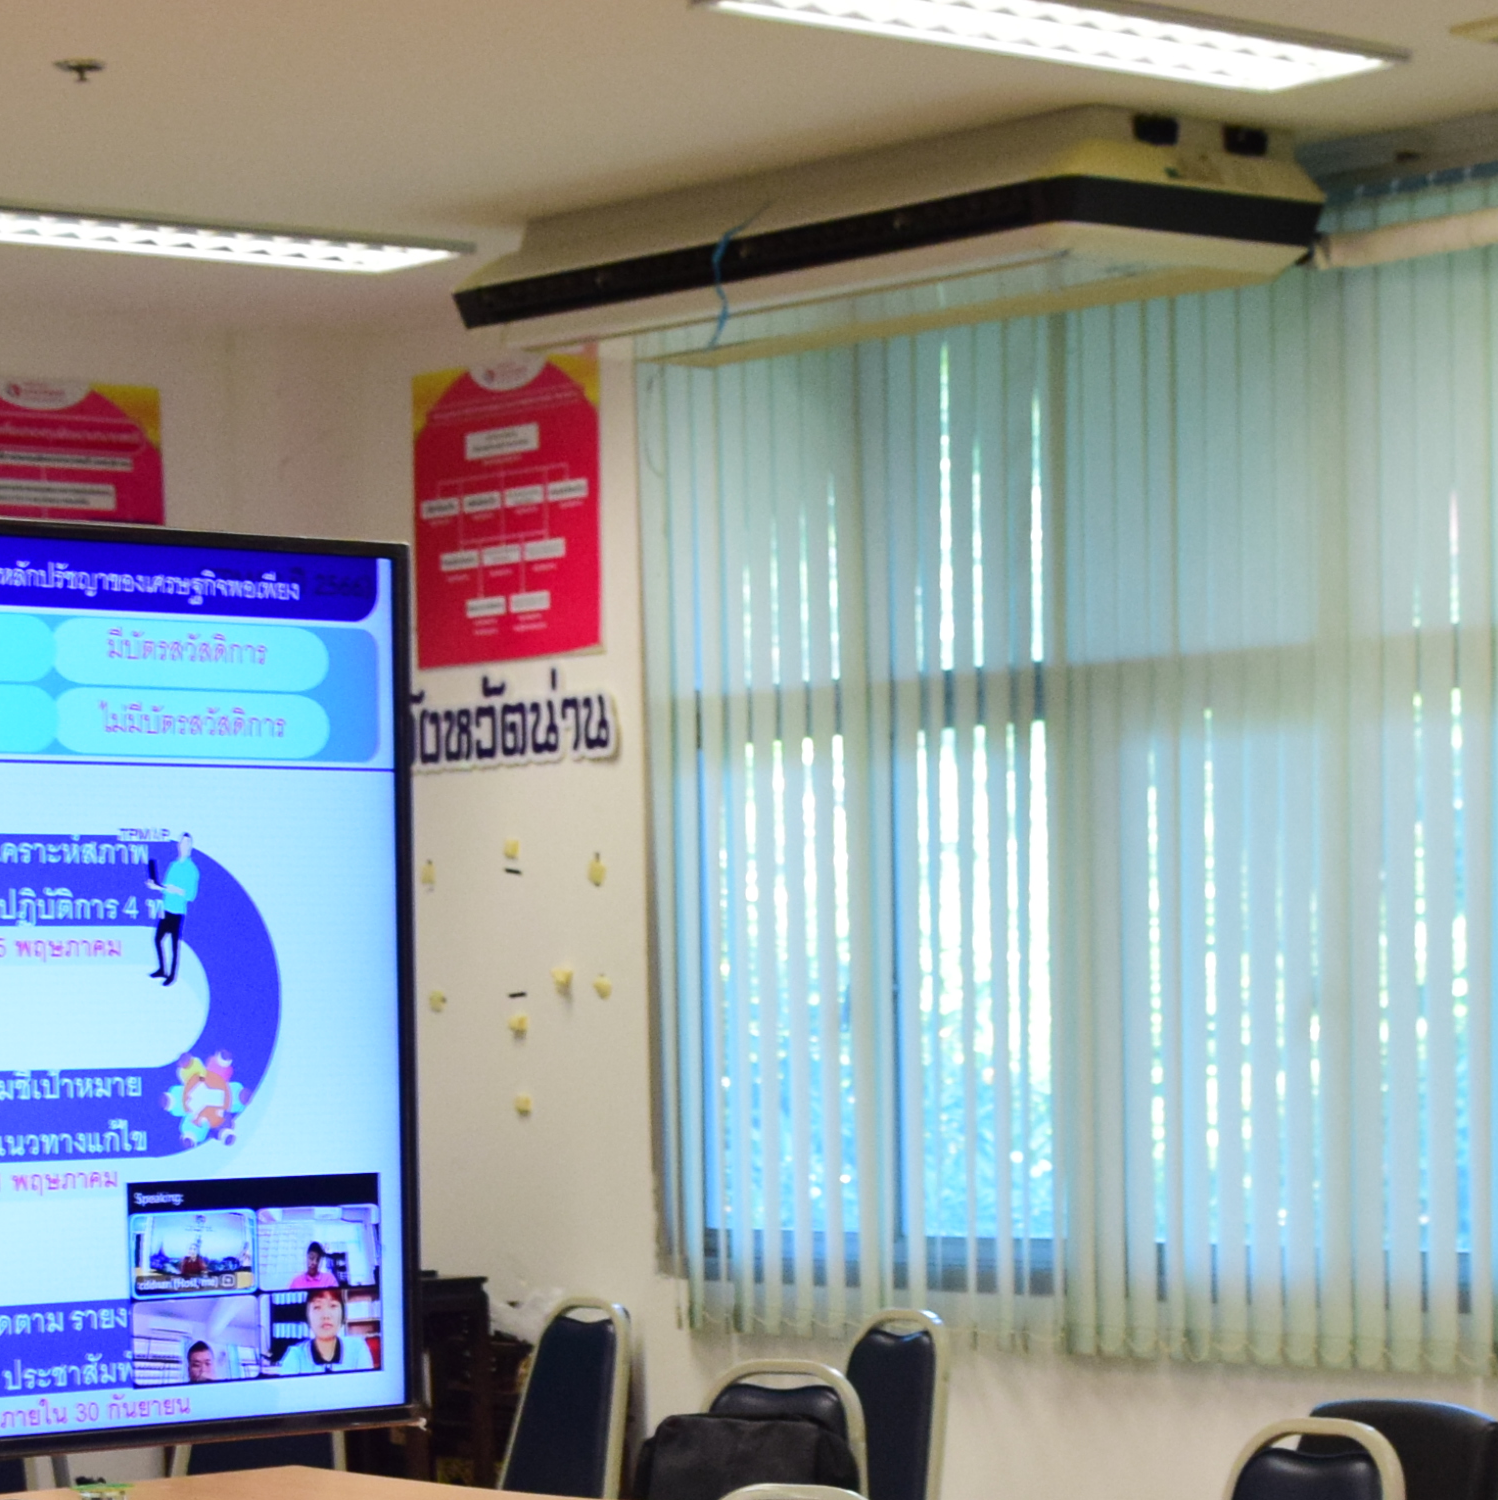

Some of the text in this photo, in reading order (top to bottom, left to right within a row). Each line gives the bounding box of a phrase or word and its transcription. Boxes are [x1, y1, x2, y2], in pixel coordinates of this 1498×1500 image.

[107, 627, 269, 665] มีบัตรสวัสดิการ
[99, 699, 287, 739] ไม่มีบัตรสวัสดิการ
[410, 668, 611, 766] ังหวัดน่าน
[121, 895, 140, 917] 4
[14, 937, 123, 963] พฤษภาคม
[12, 1169, 119, 1196] พฤษภาคม
[0, 1393, 192, 1429] ภายใน 30 กันยายน
